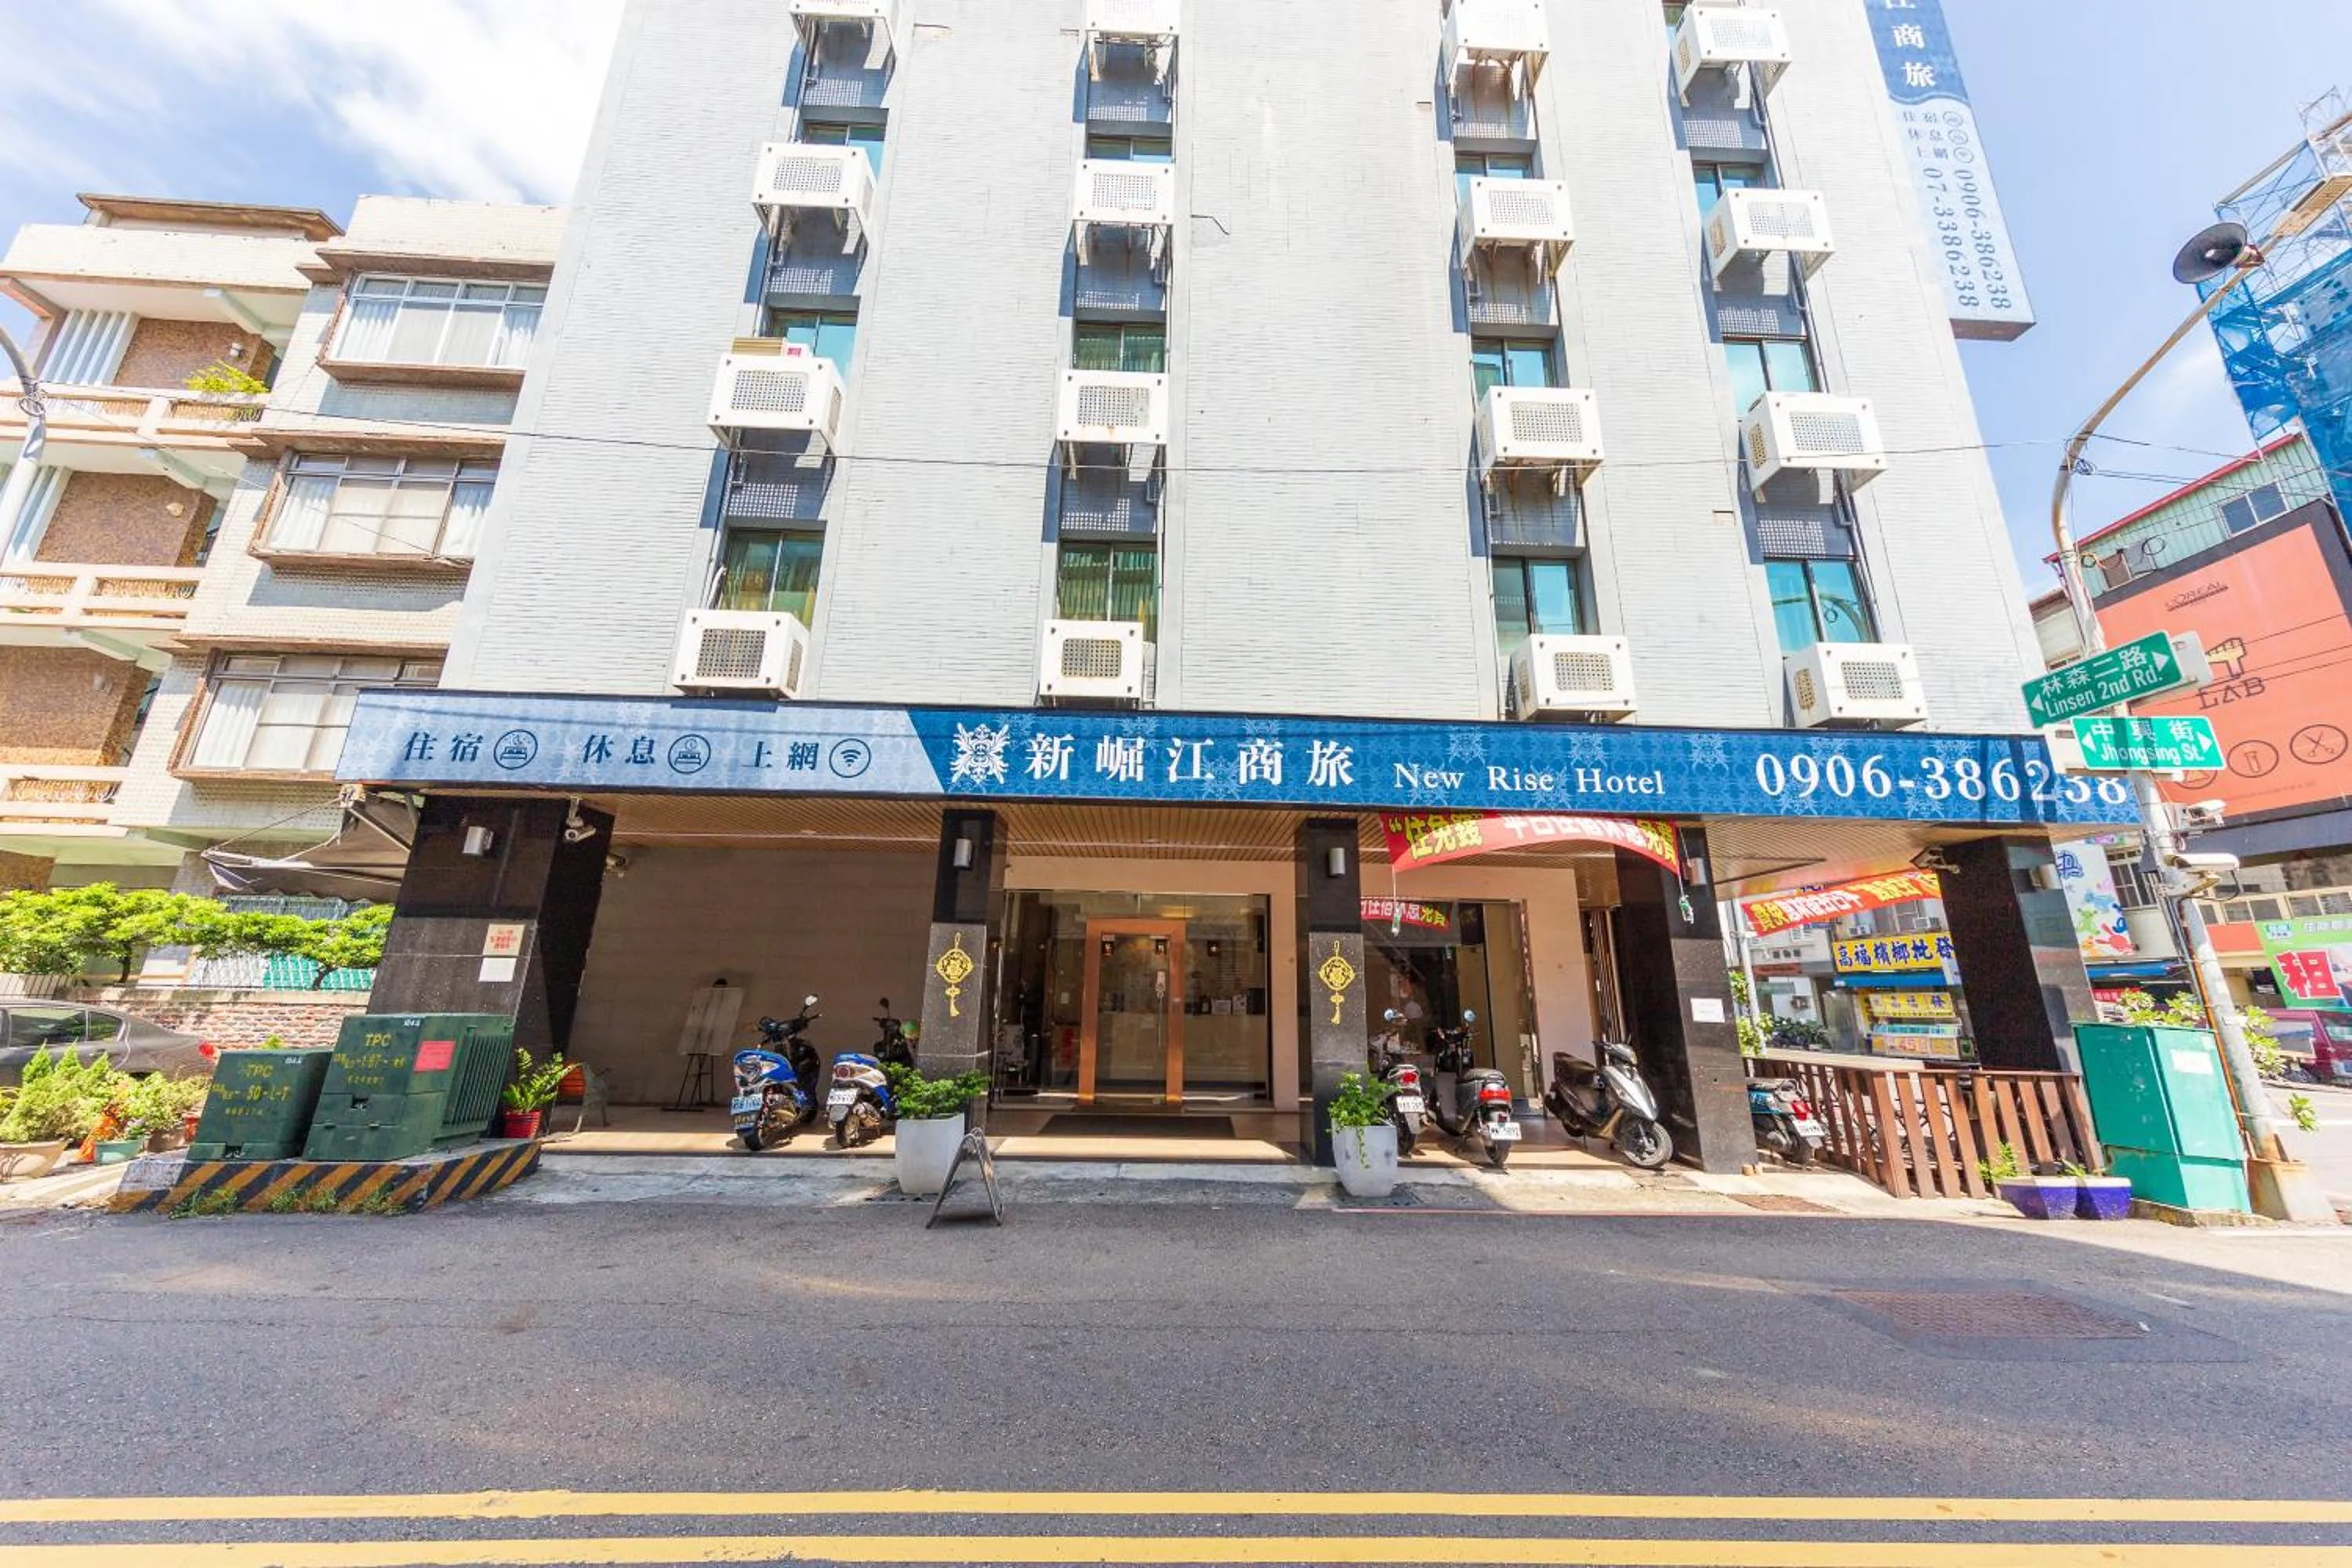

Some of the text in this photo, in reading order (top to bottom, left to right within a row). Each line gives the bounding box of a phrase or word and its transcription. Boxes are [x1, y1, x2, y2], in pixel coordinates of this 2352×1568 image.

[1886, 0, 1936, 87] 商旅
[1923, 168, 1980, 307] 07-3386238
[1954, 169, 2012, 309] 0906-386238
[2041, 645, 2147, 698] 林森二路
[2044, 665, 2163, 718] Linsen 2nd Rd.
[2197, 677, 2266, 709] LAB
[403, 730, 485, 763] 住宿
[2091, 719, 2194, 742] 中興街
[582, 734, 657, 766] 休息
[742, 740, 819, 771] 上網
[1024, 732, 1355, 788] 新崛江商旅
[2100, 743, 2181, 766] Jhongsing
[1392, 762, 1664, 795] New Rise Hotel
[364, 1033, 391, 1047] TPC
[245, 1063, 274, 1079] TPC
